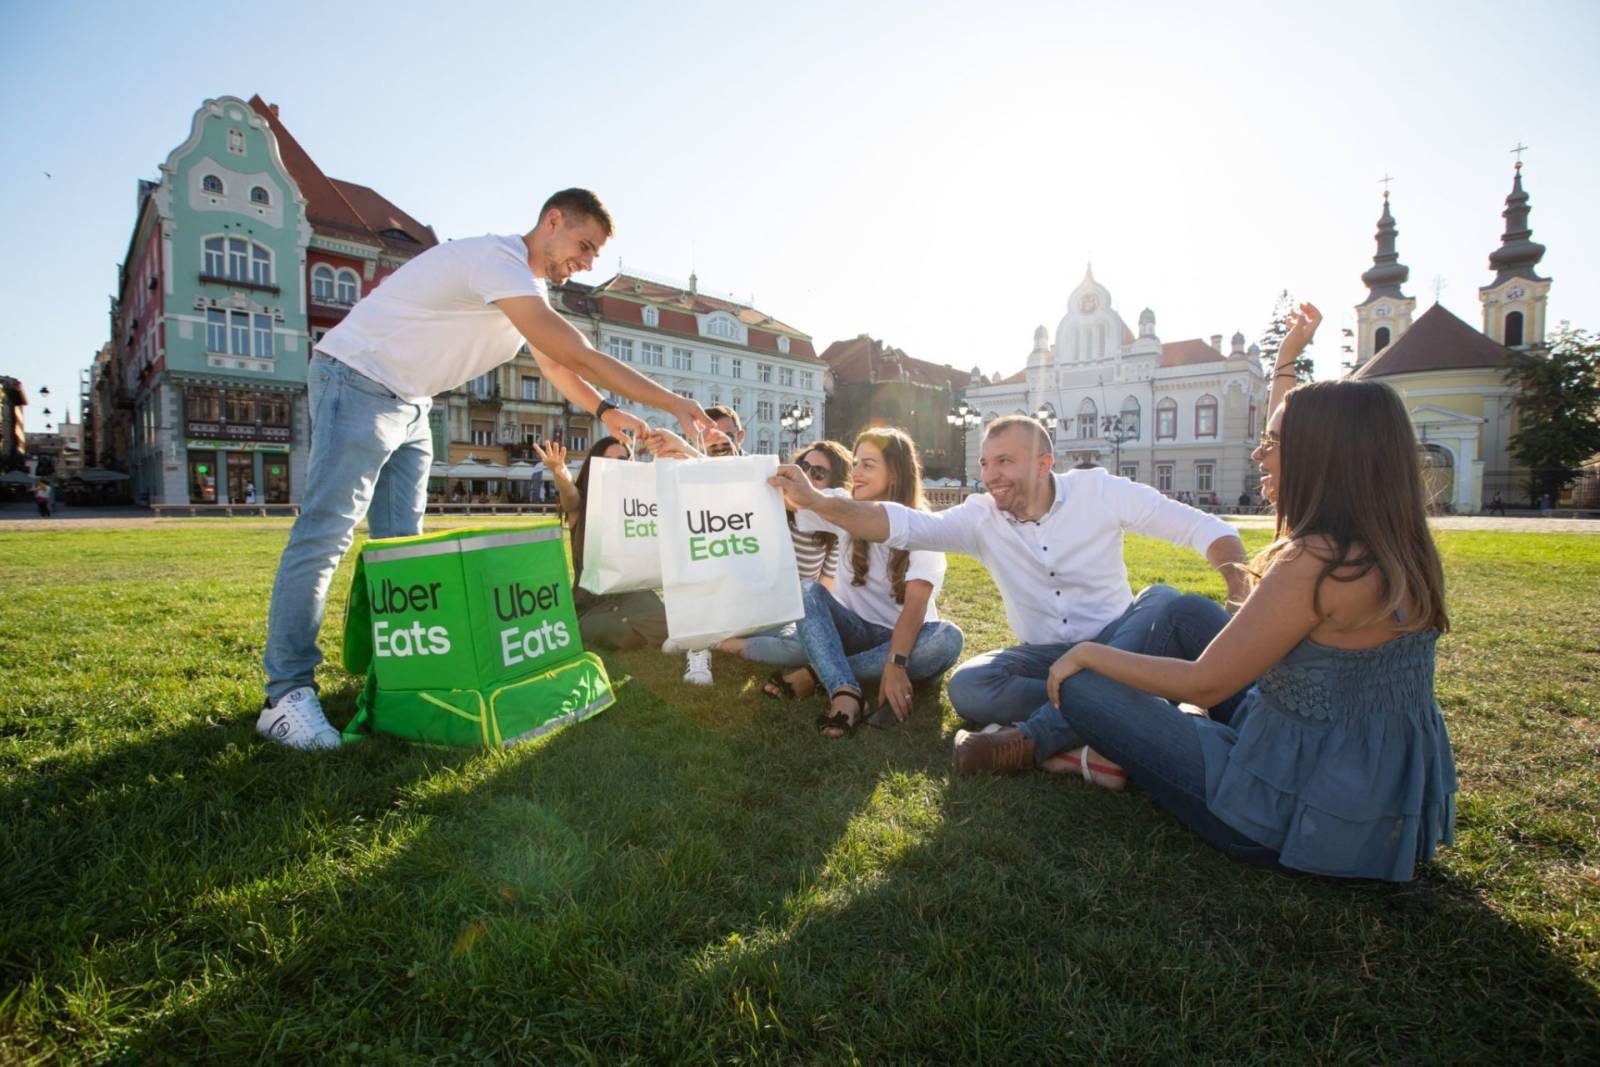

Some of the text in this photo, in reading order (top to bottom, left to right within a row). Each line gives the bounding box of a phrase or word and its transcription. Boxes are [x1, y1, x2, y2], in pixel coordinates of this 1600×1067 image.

[623, 497, 658, 517] Ube
[686, 510, 754, 534] Uber
[623, 519, 658, 538] Eat
[688, 533, 760, 561] Eats
[371, 578, 442, 614] Uber
[494, 583, 559, 622] Uber
[374, 620, 451, 657] Eats
[500, 619, 570, 667] Eats
